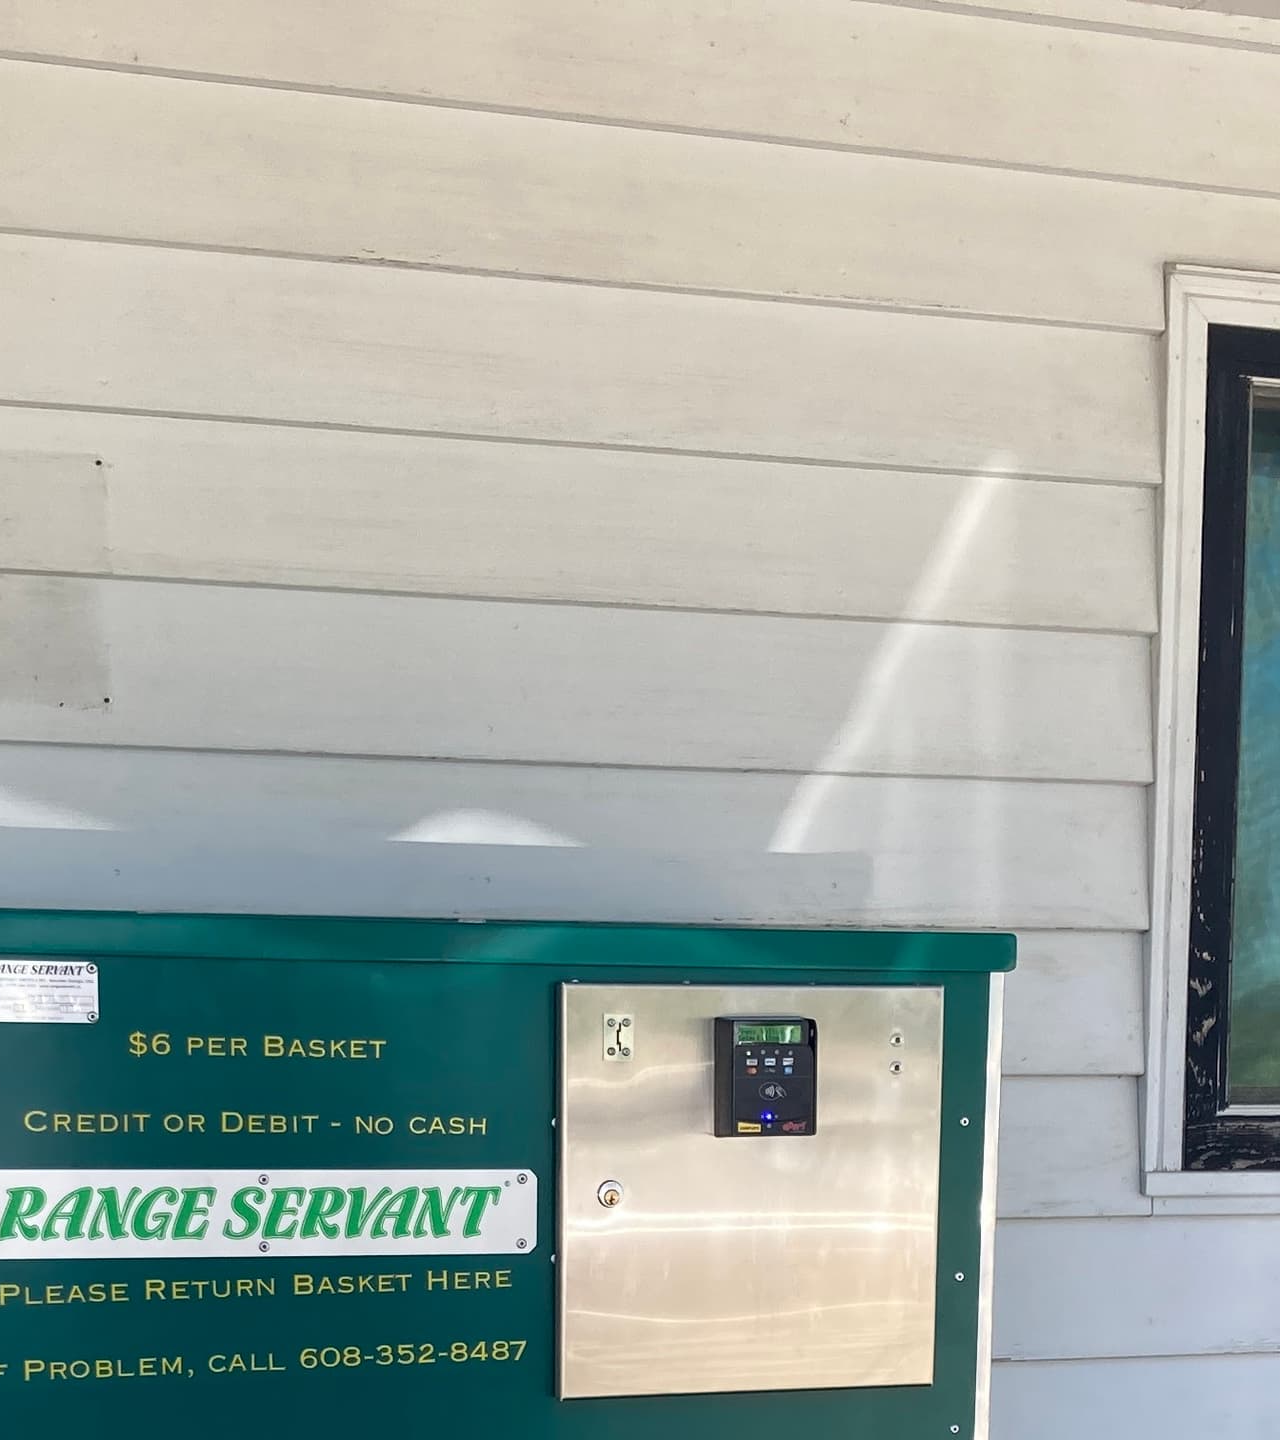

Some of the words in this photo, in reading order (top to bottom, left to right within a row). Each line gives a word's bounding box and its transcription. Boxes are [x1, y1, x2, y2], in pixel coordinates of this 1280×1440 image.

[30, 964, 84, 976] SERVANT
[128, 1031, 171, 1058] $6
[263, 1035, 387, 1059] BASKET
[23, 1110, 151, 1134] CREDIT
[221, 1111, 319, 1133] DEBIT
[222, 1185, 502, 1240] SERVANT
[145, 1278, 275, 1301] RETURN
[293, 1273, 412, 1296] BASKET
[427, 1269, 513, 1291] HERE
[299, 1340, 528, 1369] 608-352-8487
